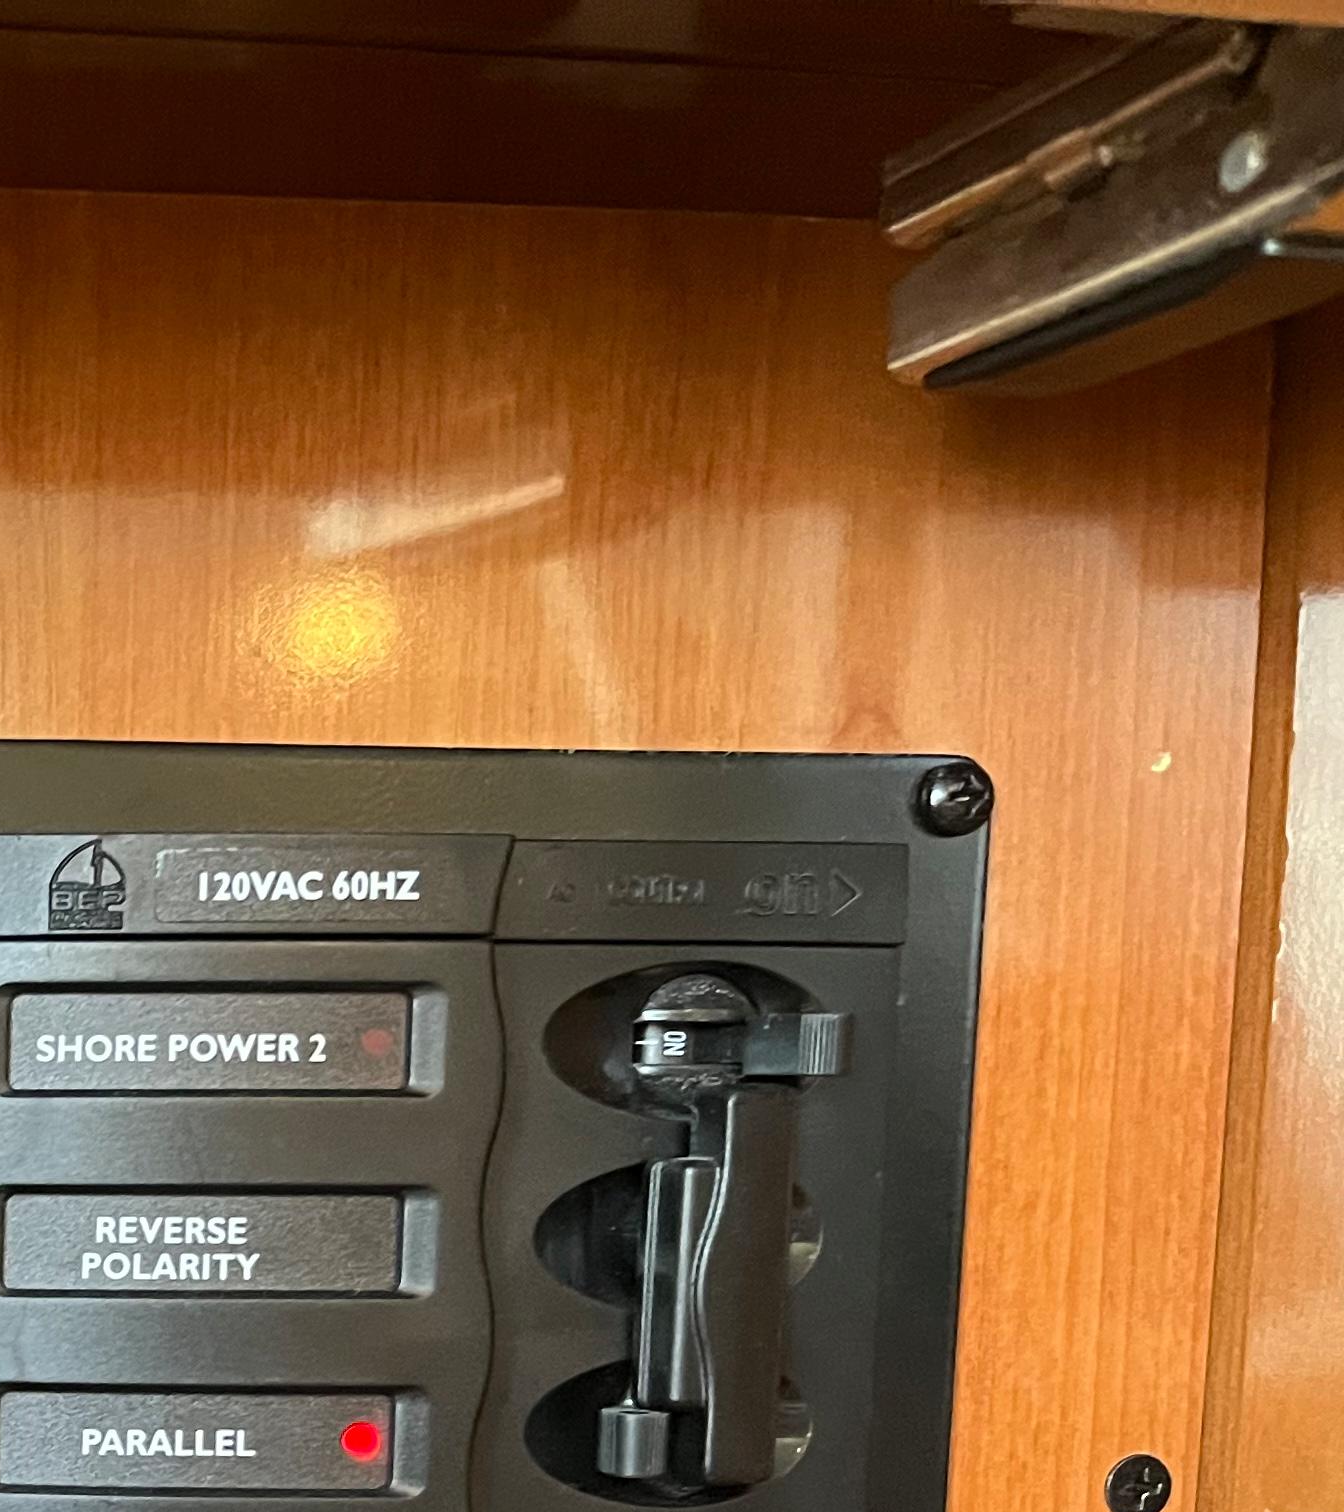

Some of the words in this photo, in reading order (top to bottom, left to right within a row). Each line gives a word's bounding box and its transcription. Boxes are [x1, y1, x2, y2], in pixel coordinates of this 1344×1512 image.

[198, 870, 324, 902] 120VAC
[331, 870, 420, 901] 60HZ
[35, 1034, 158, 1064] SHORE
[168, 1033, 300, 1062] POWER
[308, 1033, 327, 1063] 2
[95, 1216, 248, 1245] REVERSE
[81, 1252, 261, 1282] POLARITY
[81, 1428, 257, 1457] PARALLEL
